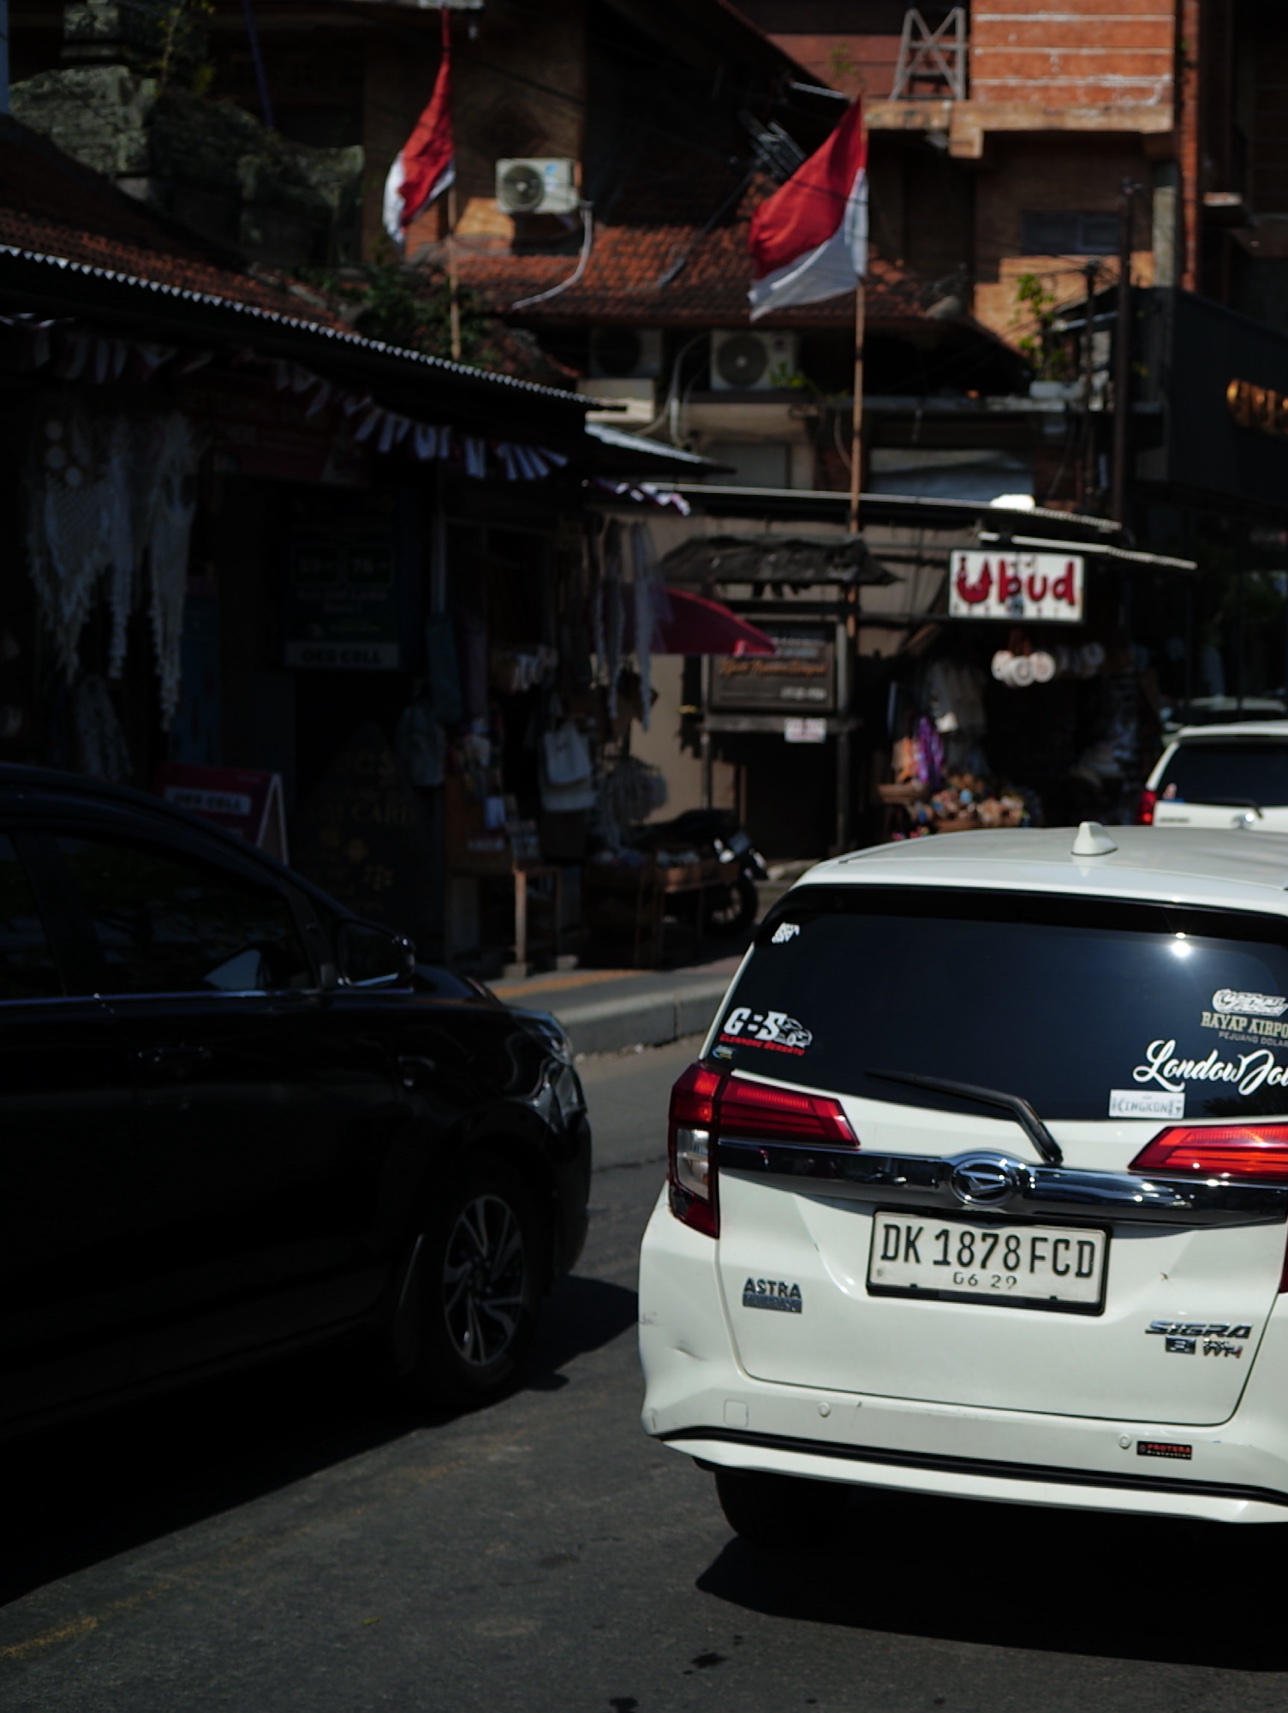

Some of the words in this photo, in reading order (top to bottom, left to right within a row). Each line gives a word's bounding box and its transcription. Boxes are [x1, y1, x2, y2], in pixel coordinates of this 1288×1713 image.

[957, 557, 1075, 606] Ubud
[880, 1223, 924, 1264] DK
[932, 1228, 1021, 1272] 1878
[1029, 1236, 1096, 1279] FCD
[744, 1277, 802, 1299] ASTRA
[1145, 1321, 1253, 1339] SIGRA
